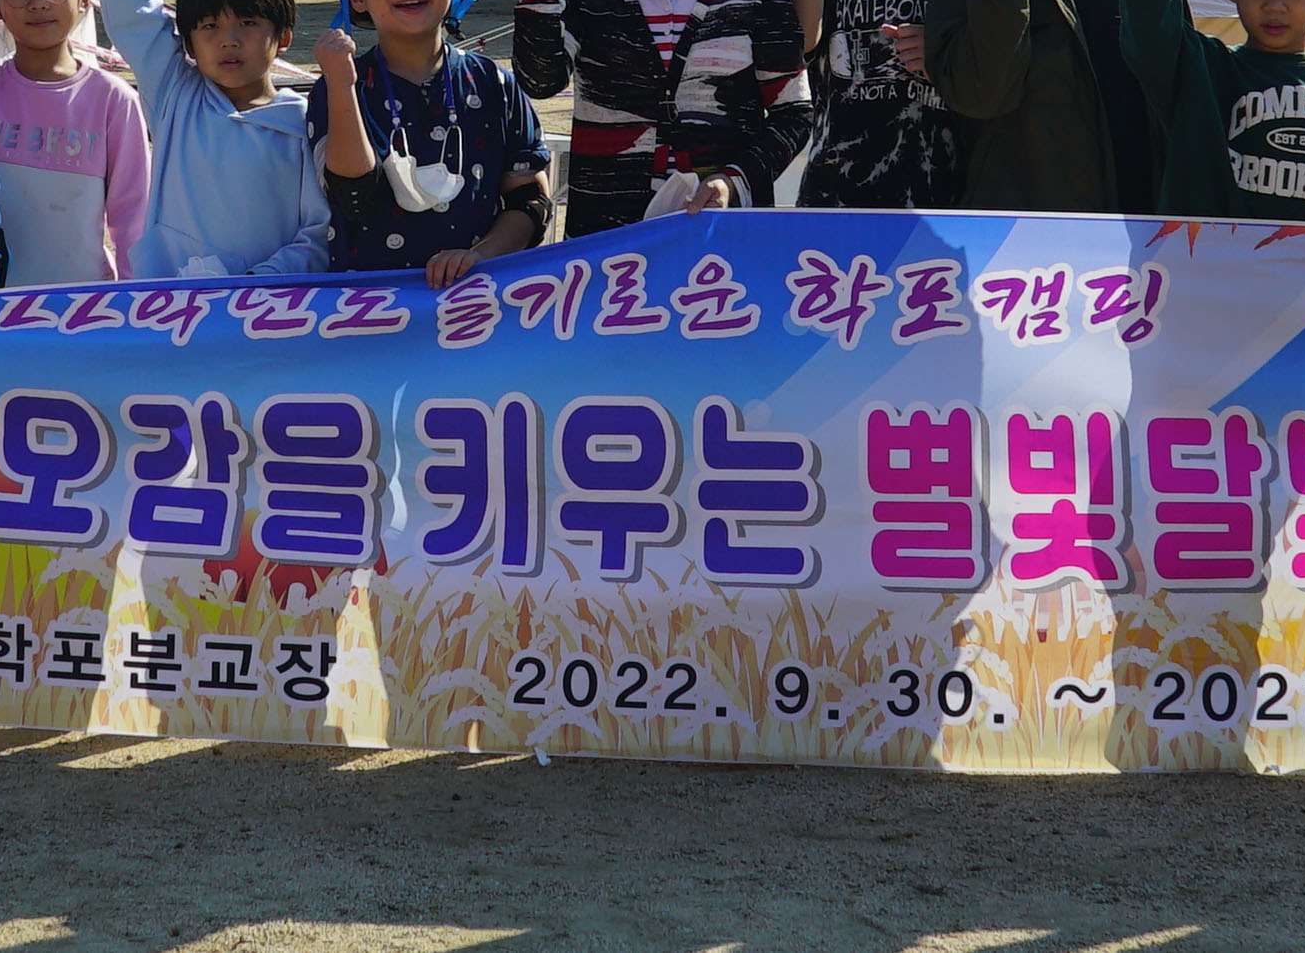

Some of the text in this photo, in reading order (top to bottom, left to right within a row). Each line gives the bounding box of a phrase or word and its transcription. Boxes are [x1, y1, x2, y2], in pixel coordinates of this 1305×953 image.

[860, 84, 886, 101] NOT
[888, 84, 898, 100] A
[27, 126, 101, 160] BEST
[1274, 133, 1297, 145] EST
[441, 253, 757, 347] 슬기로운
[790, 251, 1168, 346] 학포캠핑
[418, 397, 820, 580] 키우는
[512, 655, 728, 719] 2022.
[774, 665, 840, 721] 9.
[887, 668, 1005, 725] 30.
